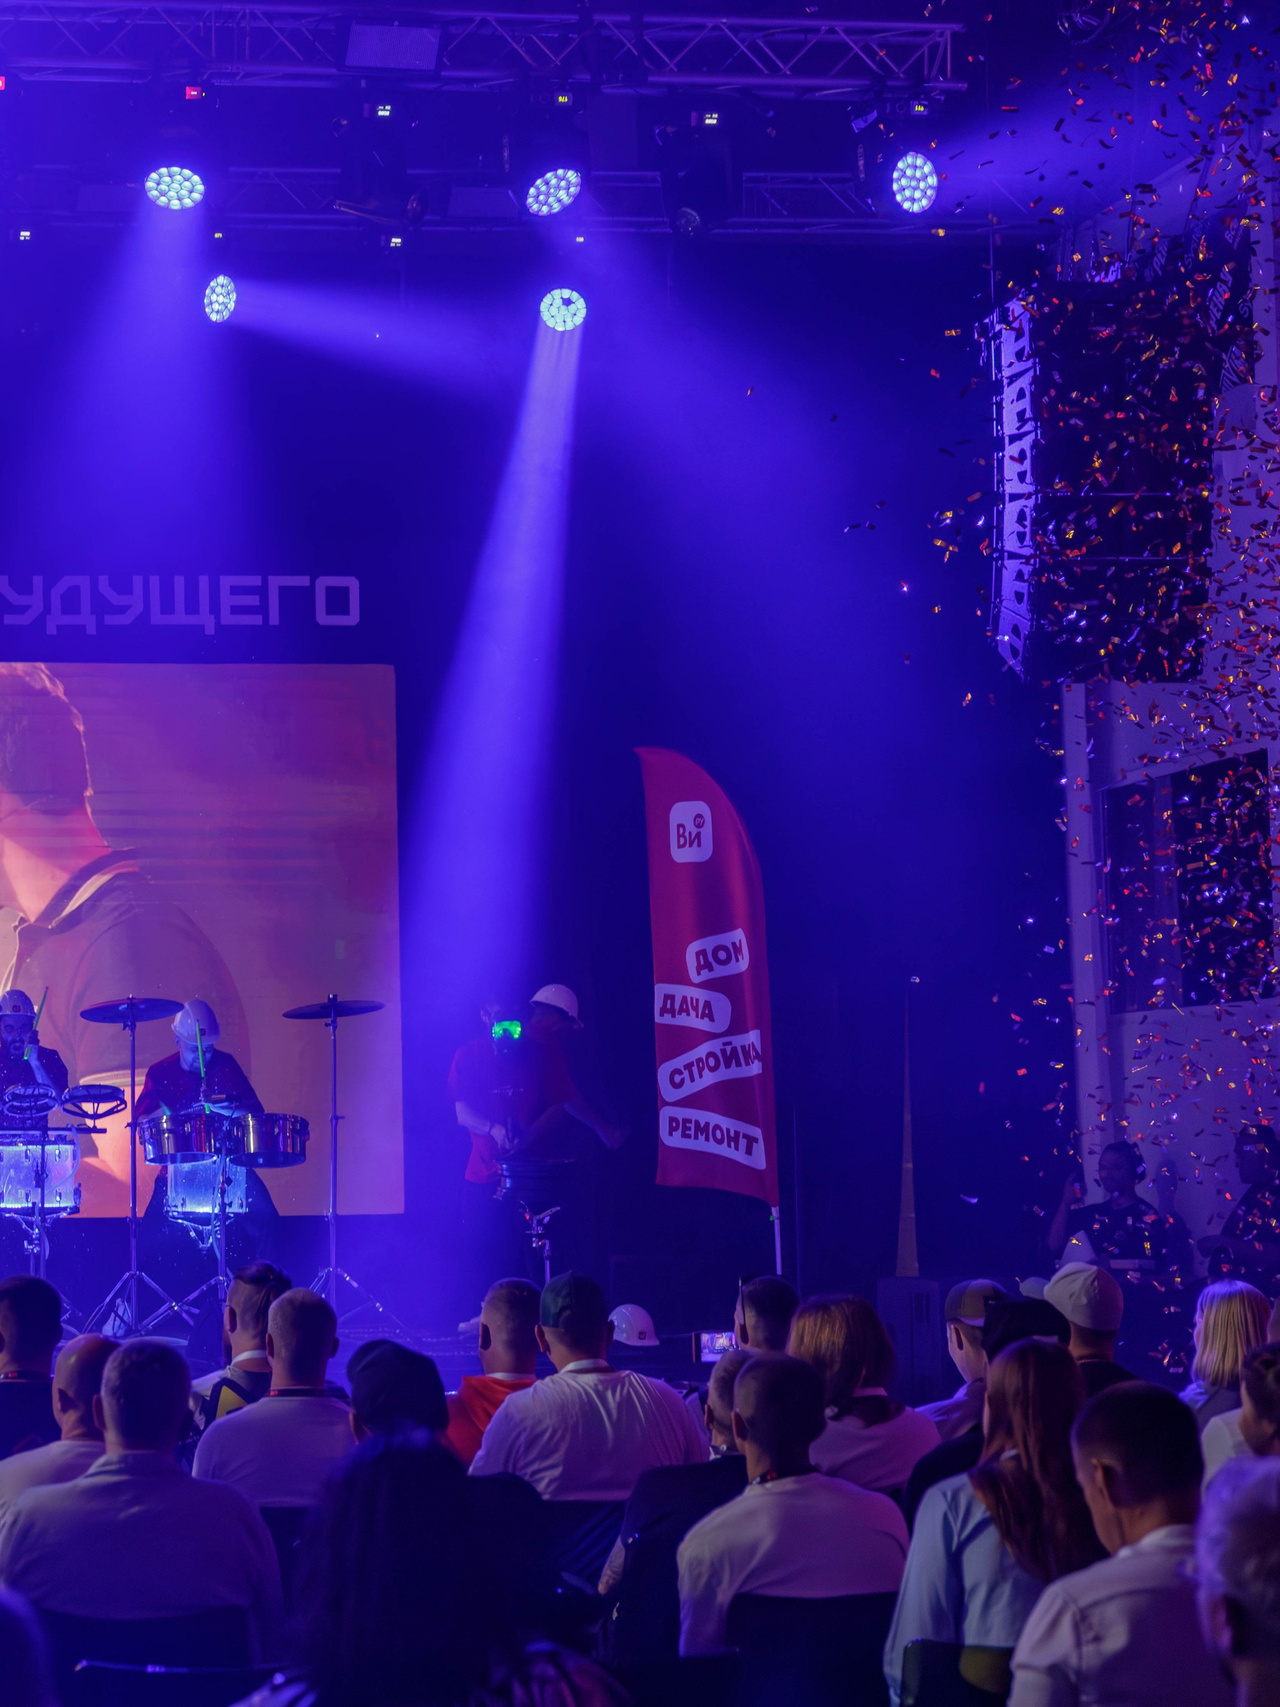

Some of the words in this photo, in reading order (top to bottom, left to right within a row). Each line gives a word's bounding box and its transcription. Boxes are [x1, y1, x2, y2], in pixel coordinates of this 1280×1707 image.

[694, 938, 744, 977] ДОМ
[658, 992, 716, 1023] ДАЧА
[668, 1041, 762, 1090] СТРОЙКА
[667, 1115, 759, 1157] РЕМОНТ
